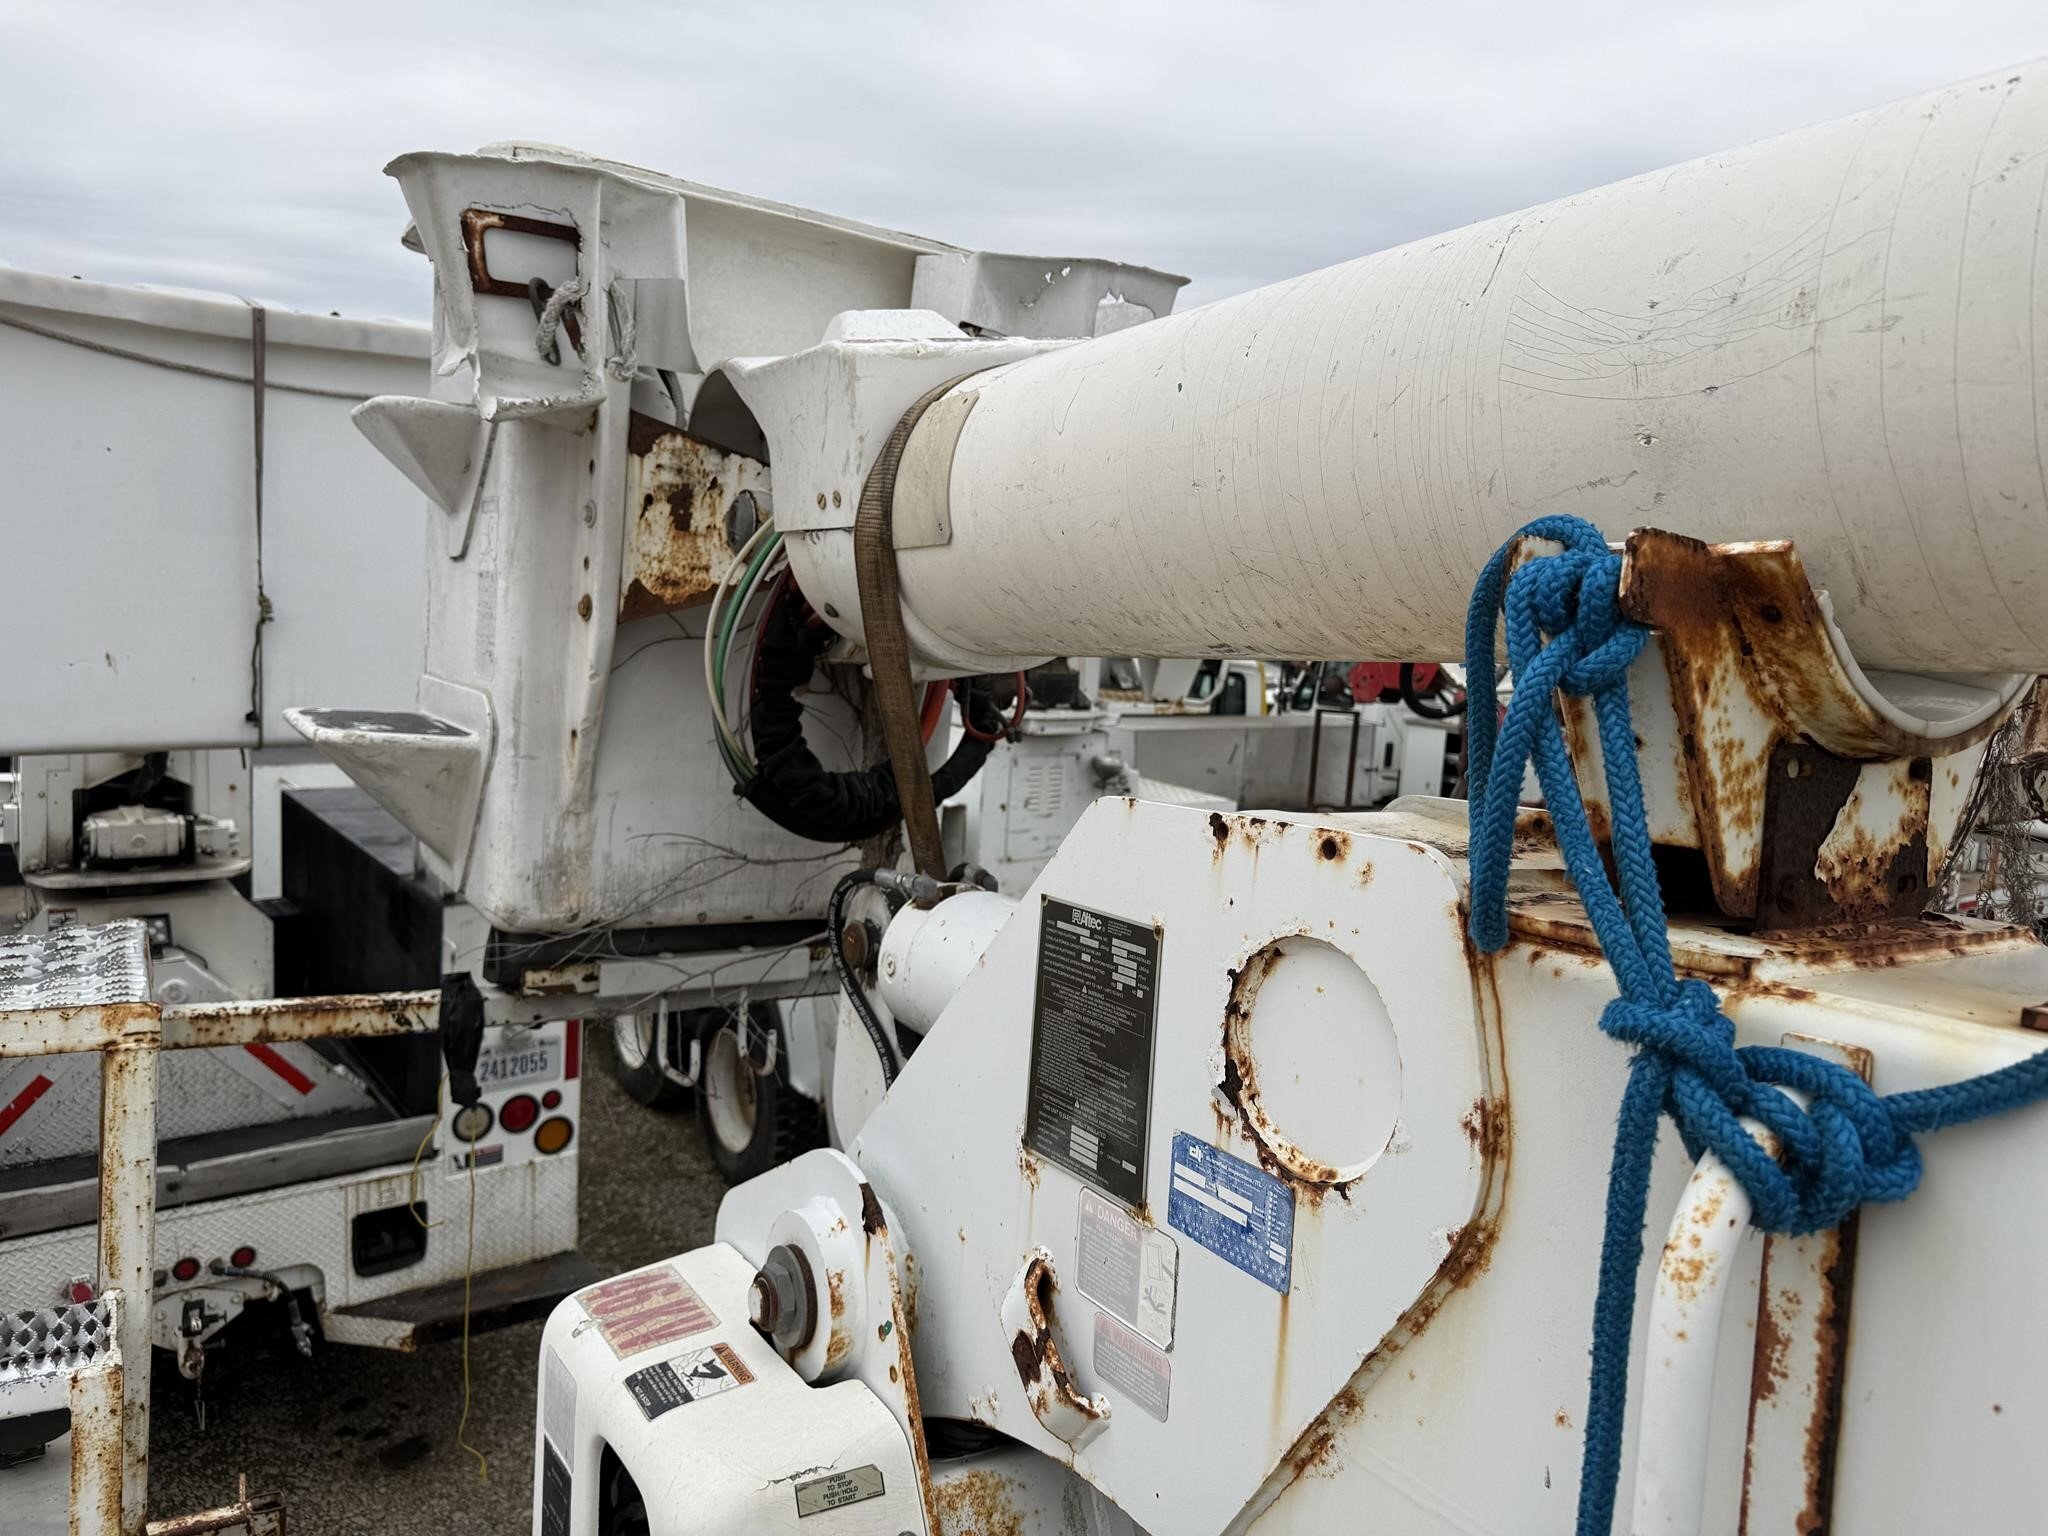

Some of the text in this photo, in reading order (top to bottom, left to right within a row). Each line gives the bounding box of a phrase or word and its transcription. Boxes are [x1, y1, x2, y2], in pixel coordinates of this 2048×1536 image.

[1080, 911, 1102, 931] Altec
[480, 1049, 548, 1082] 2412055
[1097, 1205, 1138, 1241] DANGER
[1112, 1327, 1164, 1372] WARNING
[723, 1354, 750, 1382] WARNING
[828, 1473, 845, 1483] PUSH
[837, 1479, 853, 1488] STOP
[822, 1485, 858, 1500] PUSH/HOLD
[827, 1498, 835, 1506] TO
[837, 1492, 856, 1503] START
